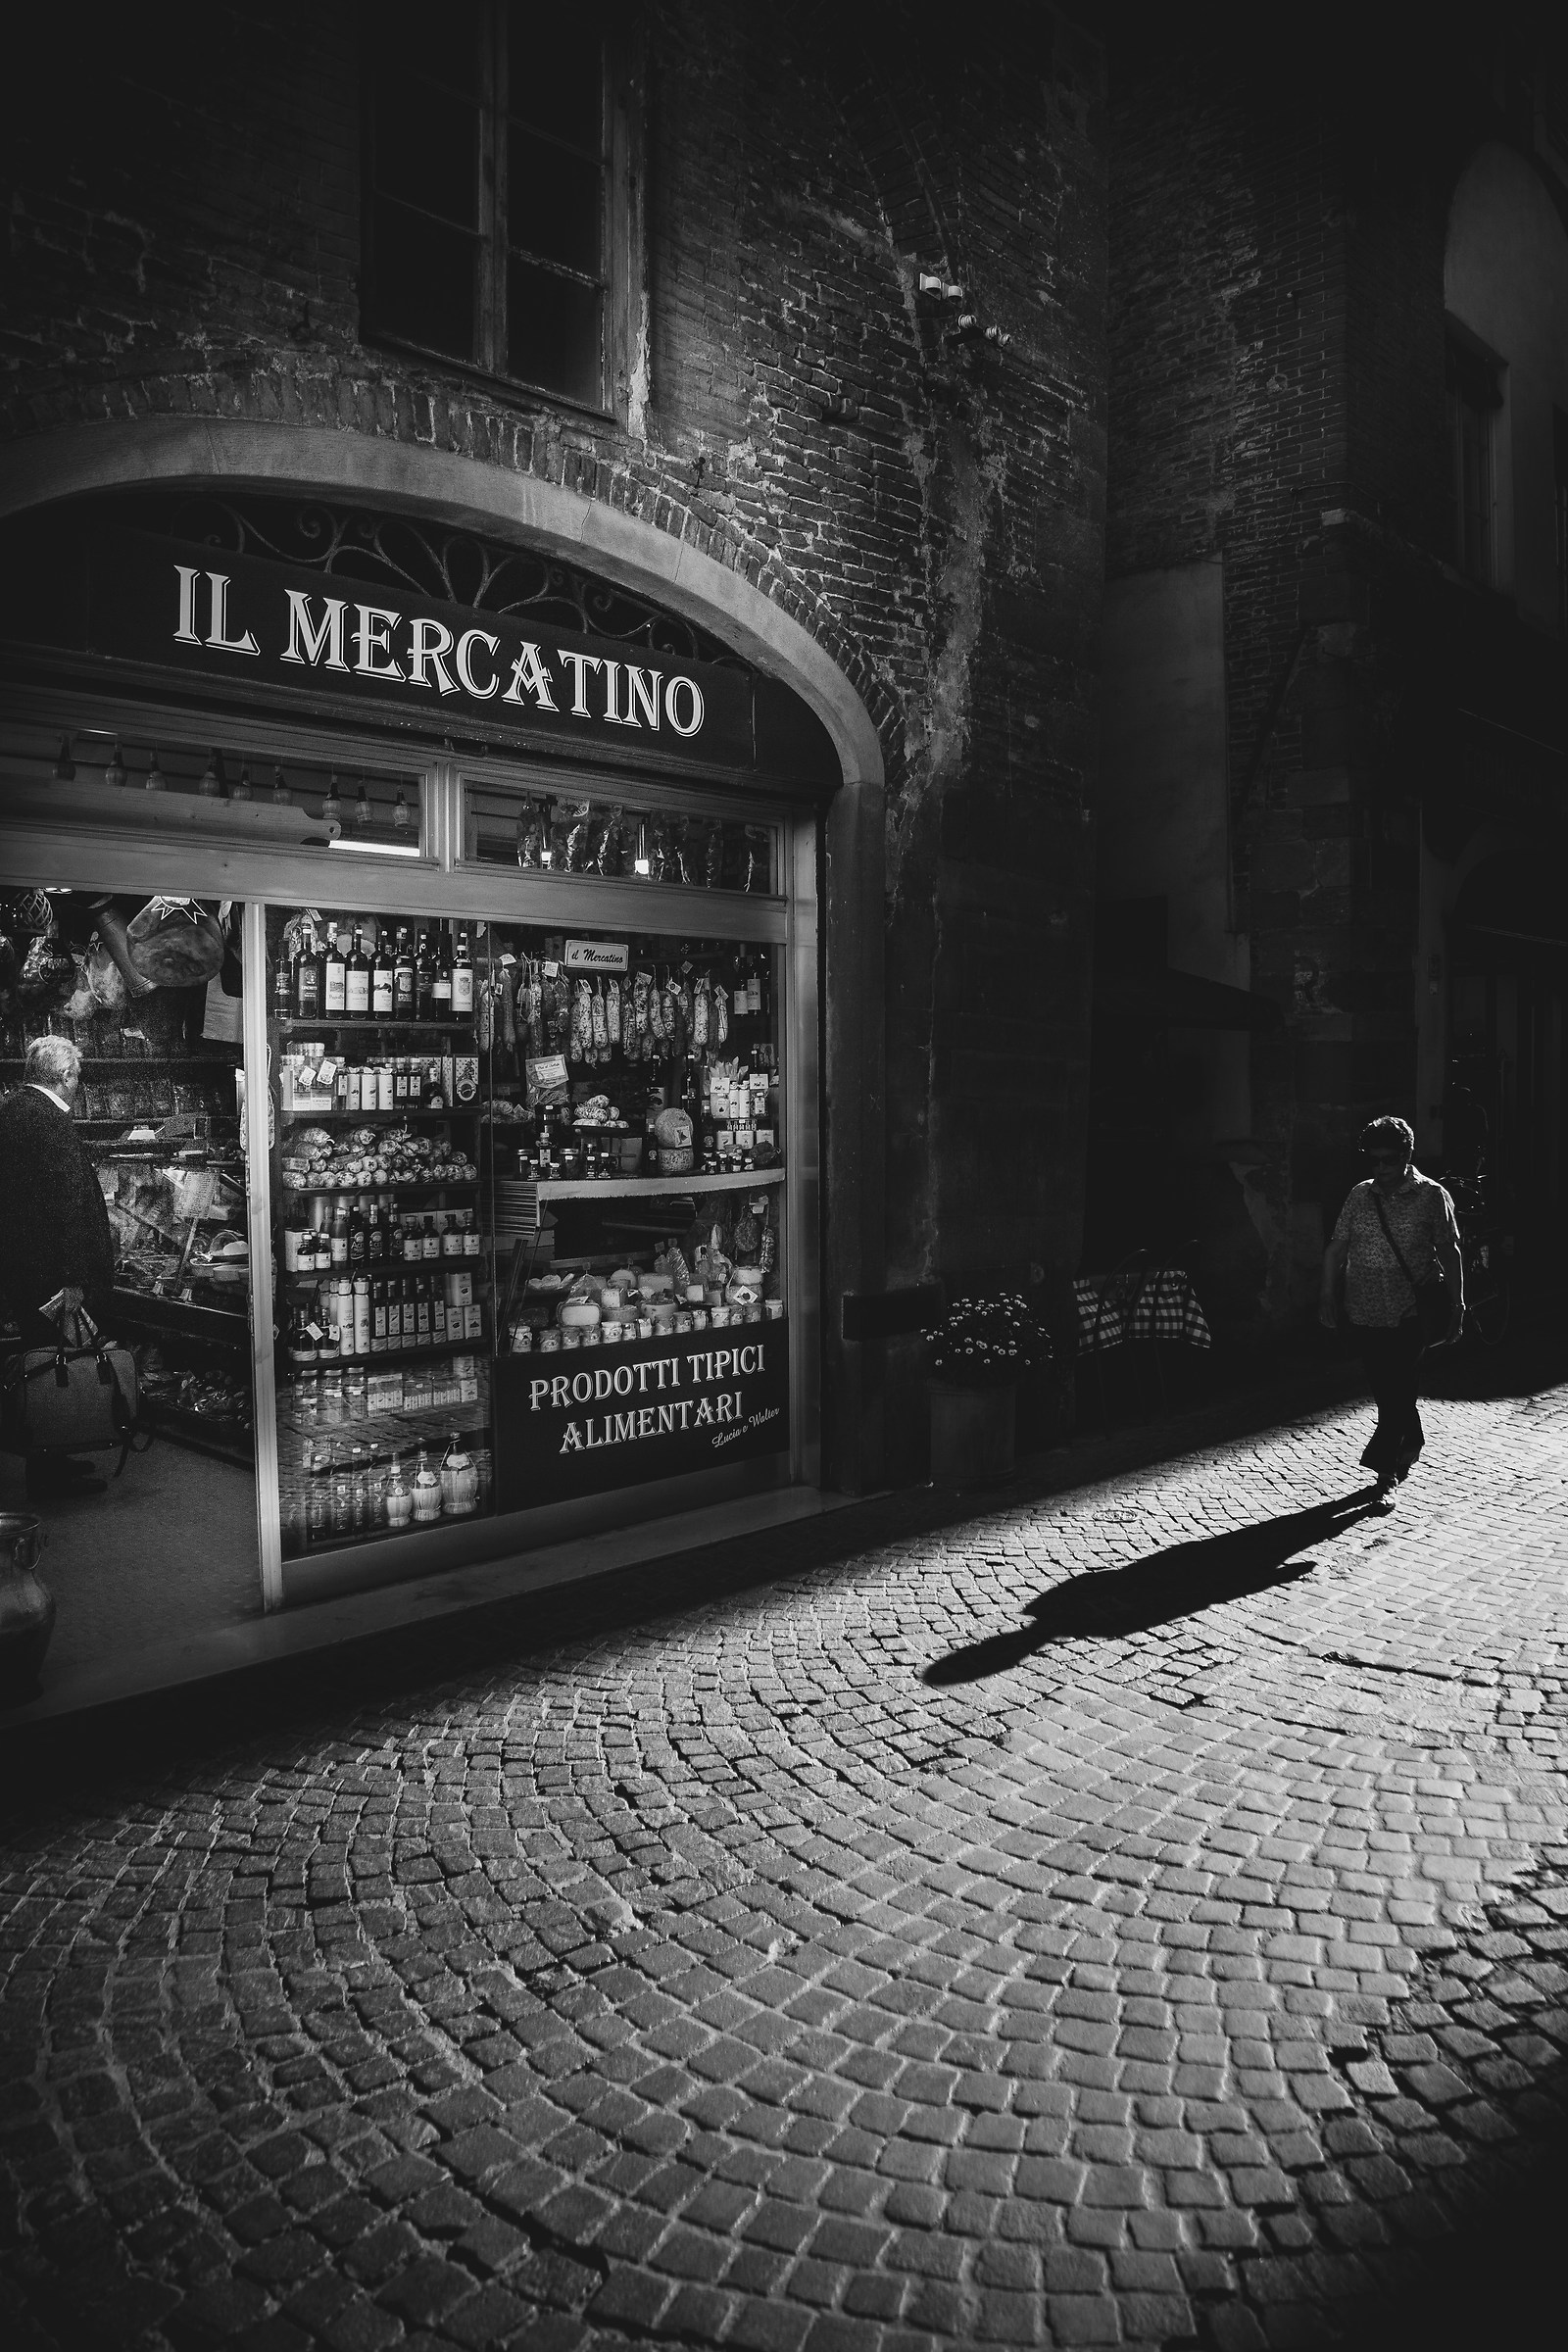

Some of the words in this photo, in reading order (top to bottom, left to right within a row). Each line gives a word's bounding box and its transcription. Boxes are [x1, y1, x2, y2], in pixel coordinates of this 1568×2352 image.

[172, 564, 261, 656] IL
[279, 588, 706, 738] MERCATINO
[571, 950, 579, 960] il
[583, 949, 623, 963] Mercatino
[528, 1357, 680, 1411] PRODOTTI
[686, 1344, 765, 1385] TIPICI
[559, 1391, 743, 1454] ALIMENTARI
[711, 1428, 742, 1448] Lucia
[749, 1407, 780, 1428] Walter
